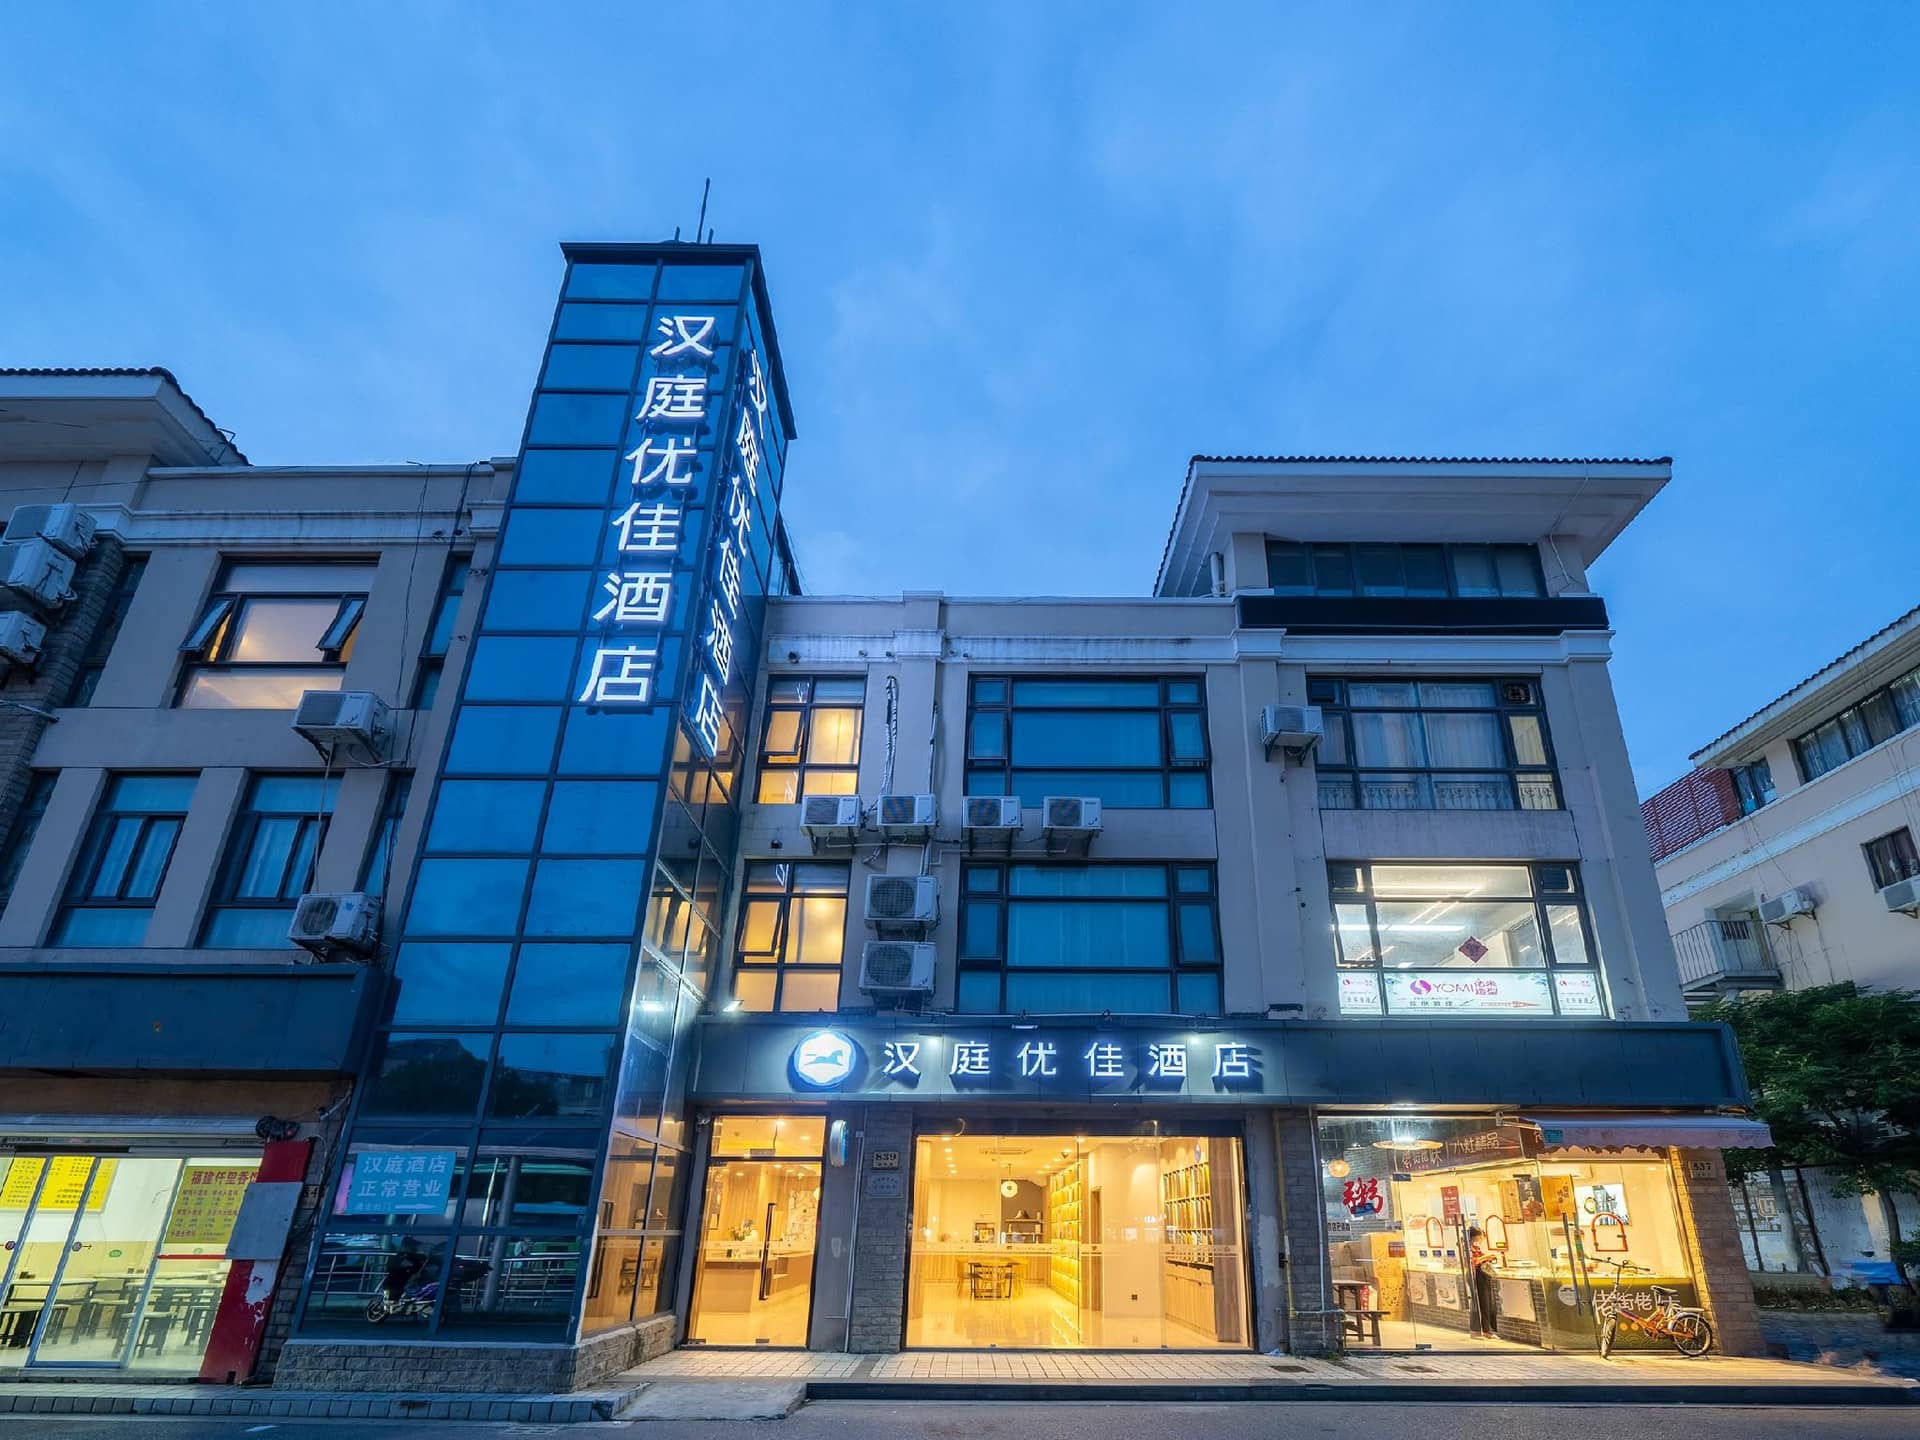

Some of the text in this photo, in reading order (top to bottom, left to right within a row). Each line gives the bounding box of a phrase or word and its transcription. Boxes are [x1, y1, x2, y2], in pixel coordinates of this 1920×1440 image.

[578, 315, 717, 704] 汉庭优佳酒店
[695, 349, 768, 758] 汉庭优佳酒店
[1433, 983, 1474, 993] YOMI
[884, 1041, 1251, 1078] 汉庭优佳酒店
[363, 1155, 448, 1174] 汉庭酒店
[875, 1152, 897, 1161] 839
[357, 1179, 443, 1198] 正常营业
[1342, 1177, 1384, 1215] 粥
